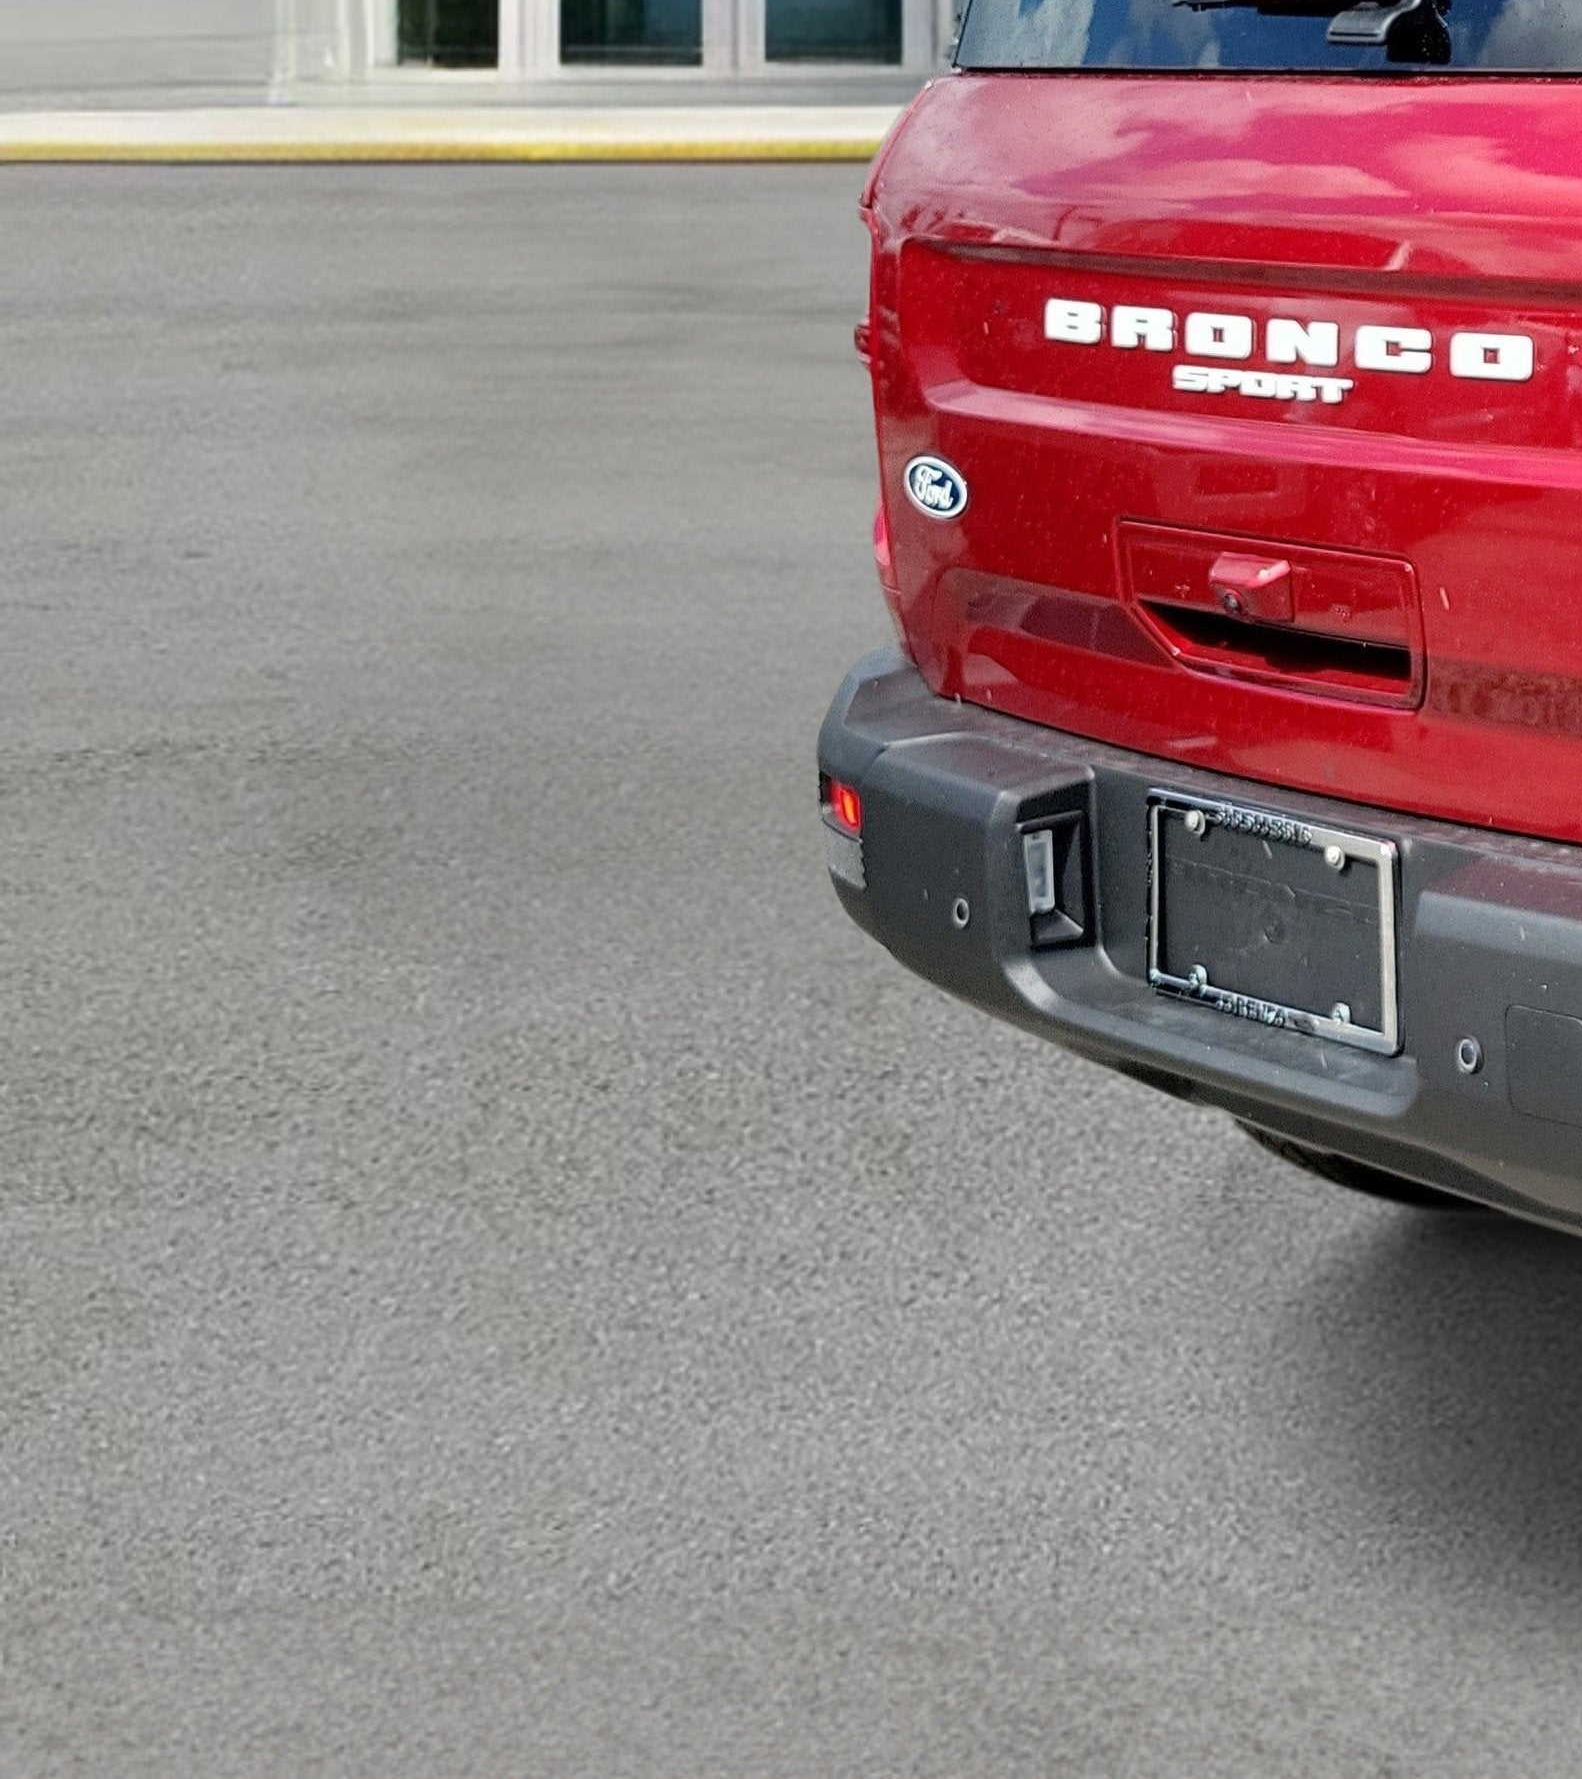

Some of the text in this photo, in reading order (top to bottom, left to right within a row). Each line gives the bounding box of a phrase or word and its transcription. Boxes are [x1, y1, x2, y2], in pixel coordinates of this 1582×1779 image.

[1044, 298, 1534, 381] BRONCO
[1172, 363, 1354, 404] SPORT
[914, 465, 954, 509] Ford
